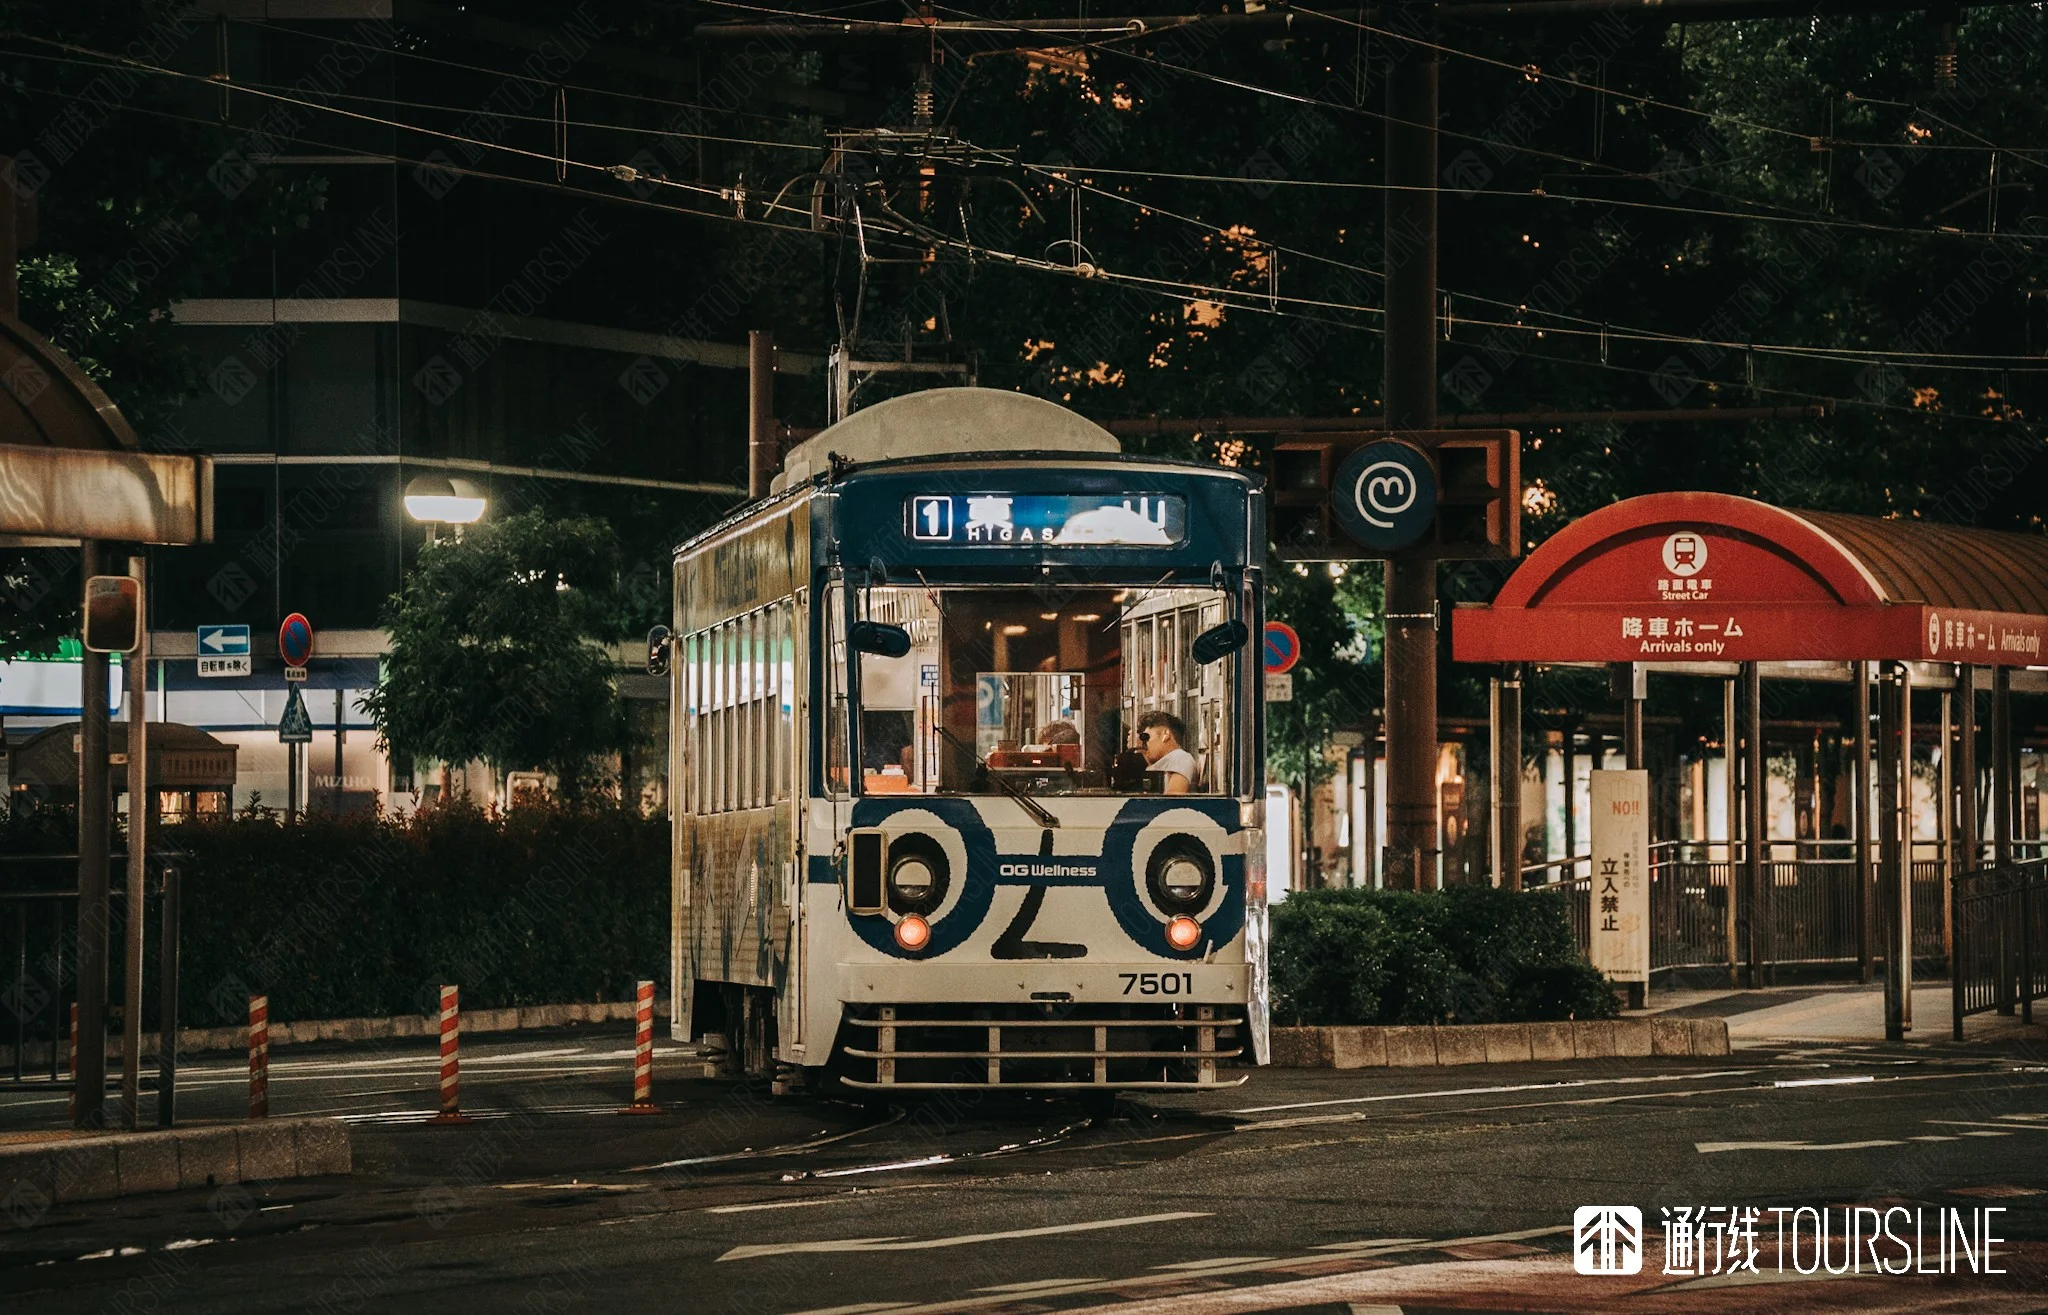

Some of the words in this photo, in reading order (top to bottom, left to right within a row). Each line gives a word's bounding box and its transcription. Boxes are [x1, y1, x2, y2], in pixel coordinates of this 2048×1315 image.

[922, 500, 939, 536] 1
[1657, 579, 1713, 591] 路面電車
[1662, 590, 1690, 600] Street
[1692, 590, 1708, 600] Car
[1622, 617, 1744, 639] 降車ホーム
[1640, 640, 1692, 653] Arrivals
[1694, 639, 1725, 655] only
[2000, 627, 2025, 652] Arrivals
[2025, 630, 2041, 659] only
[201, 659, 248, 673] 自転車を除く
[1612, 800, 1640, 815] NO!!
[1000, 864, 1029, 877] OG
[1031, 864, 1097, 877] Wellness
[1600, 857, 1619, 932] 立入禁止
[1119, 973, 1192, 996] 7501
